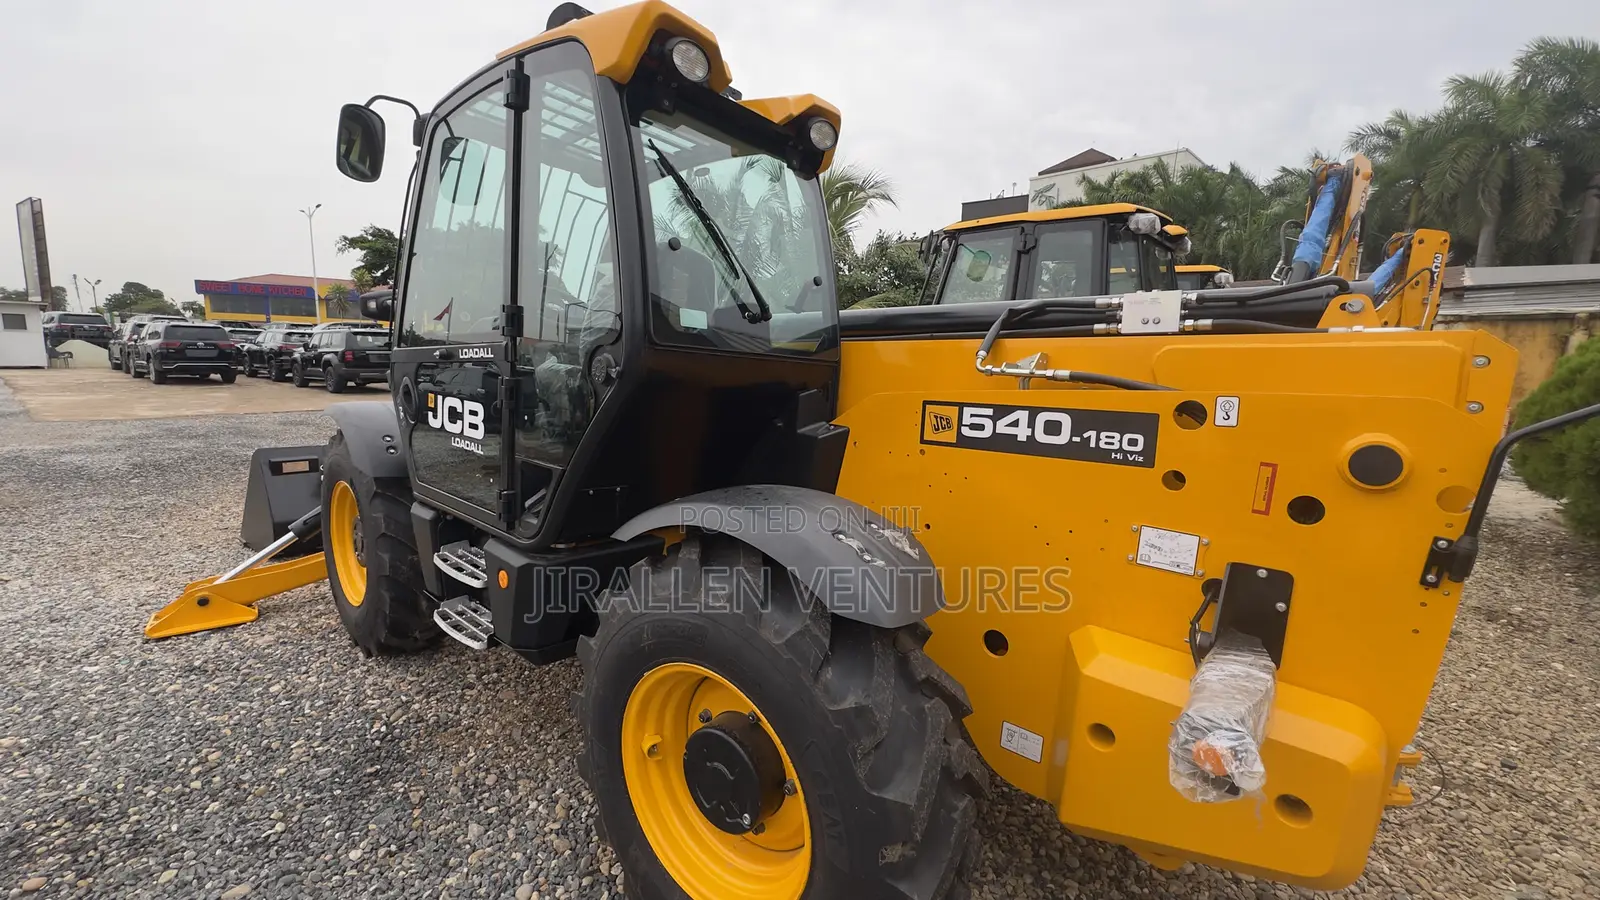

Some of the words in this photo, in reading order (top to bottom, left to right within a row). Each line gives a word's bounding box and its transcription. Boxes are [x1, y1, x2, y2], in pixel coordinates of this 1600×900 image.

[199, 281, 232, 292] SWEET
[238, 284, 265, 294] HOME
[269, 287, 306, 296] KITCHEN
[459, 348, 494, 358] LOADALL
[427, 394, 485, 440] JCB
[932, 413, 953, 433] JCB
[960, 406, 1145, 452] 540-180
[451, 437, 484, 455] LOADALL
[1111, 452, 1123, 460] Hi
[1127, 453, 1144, 462] Viz
